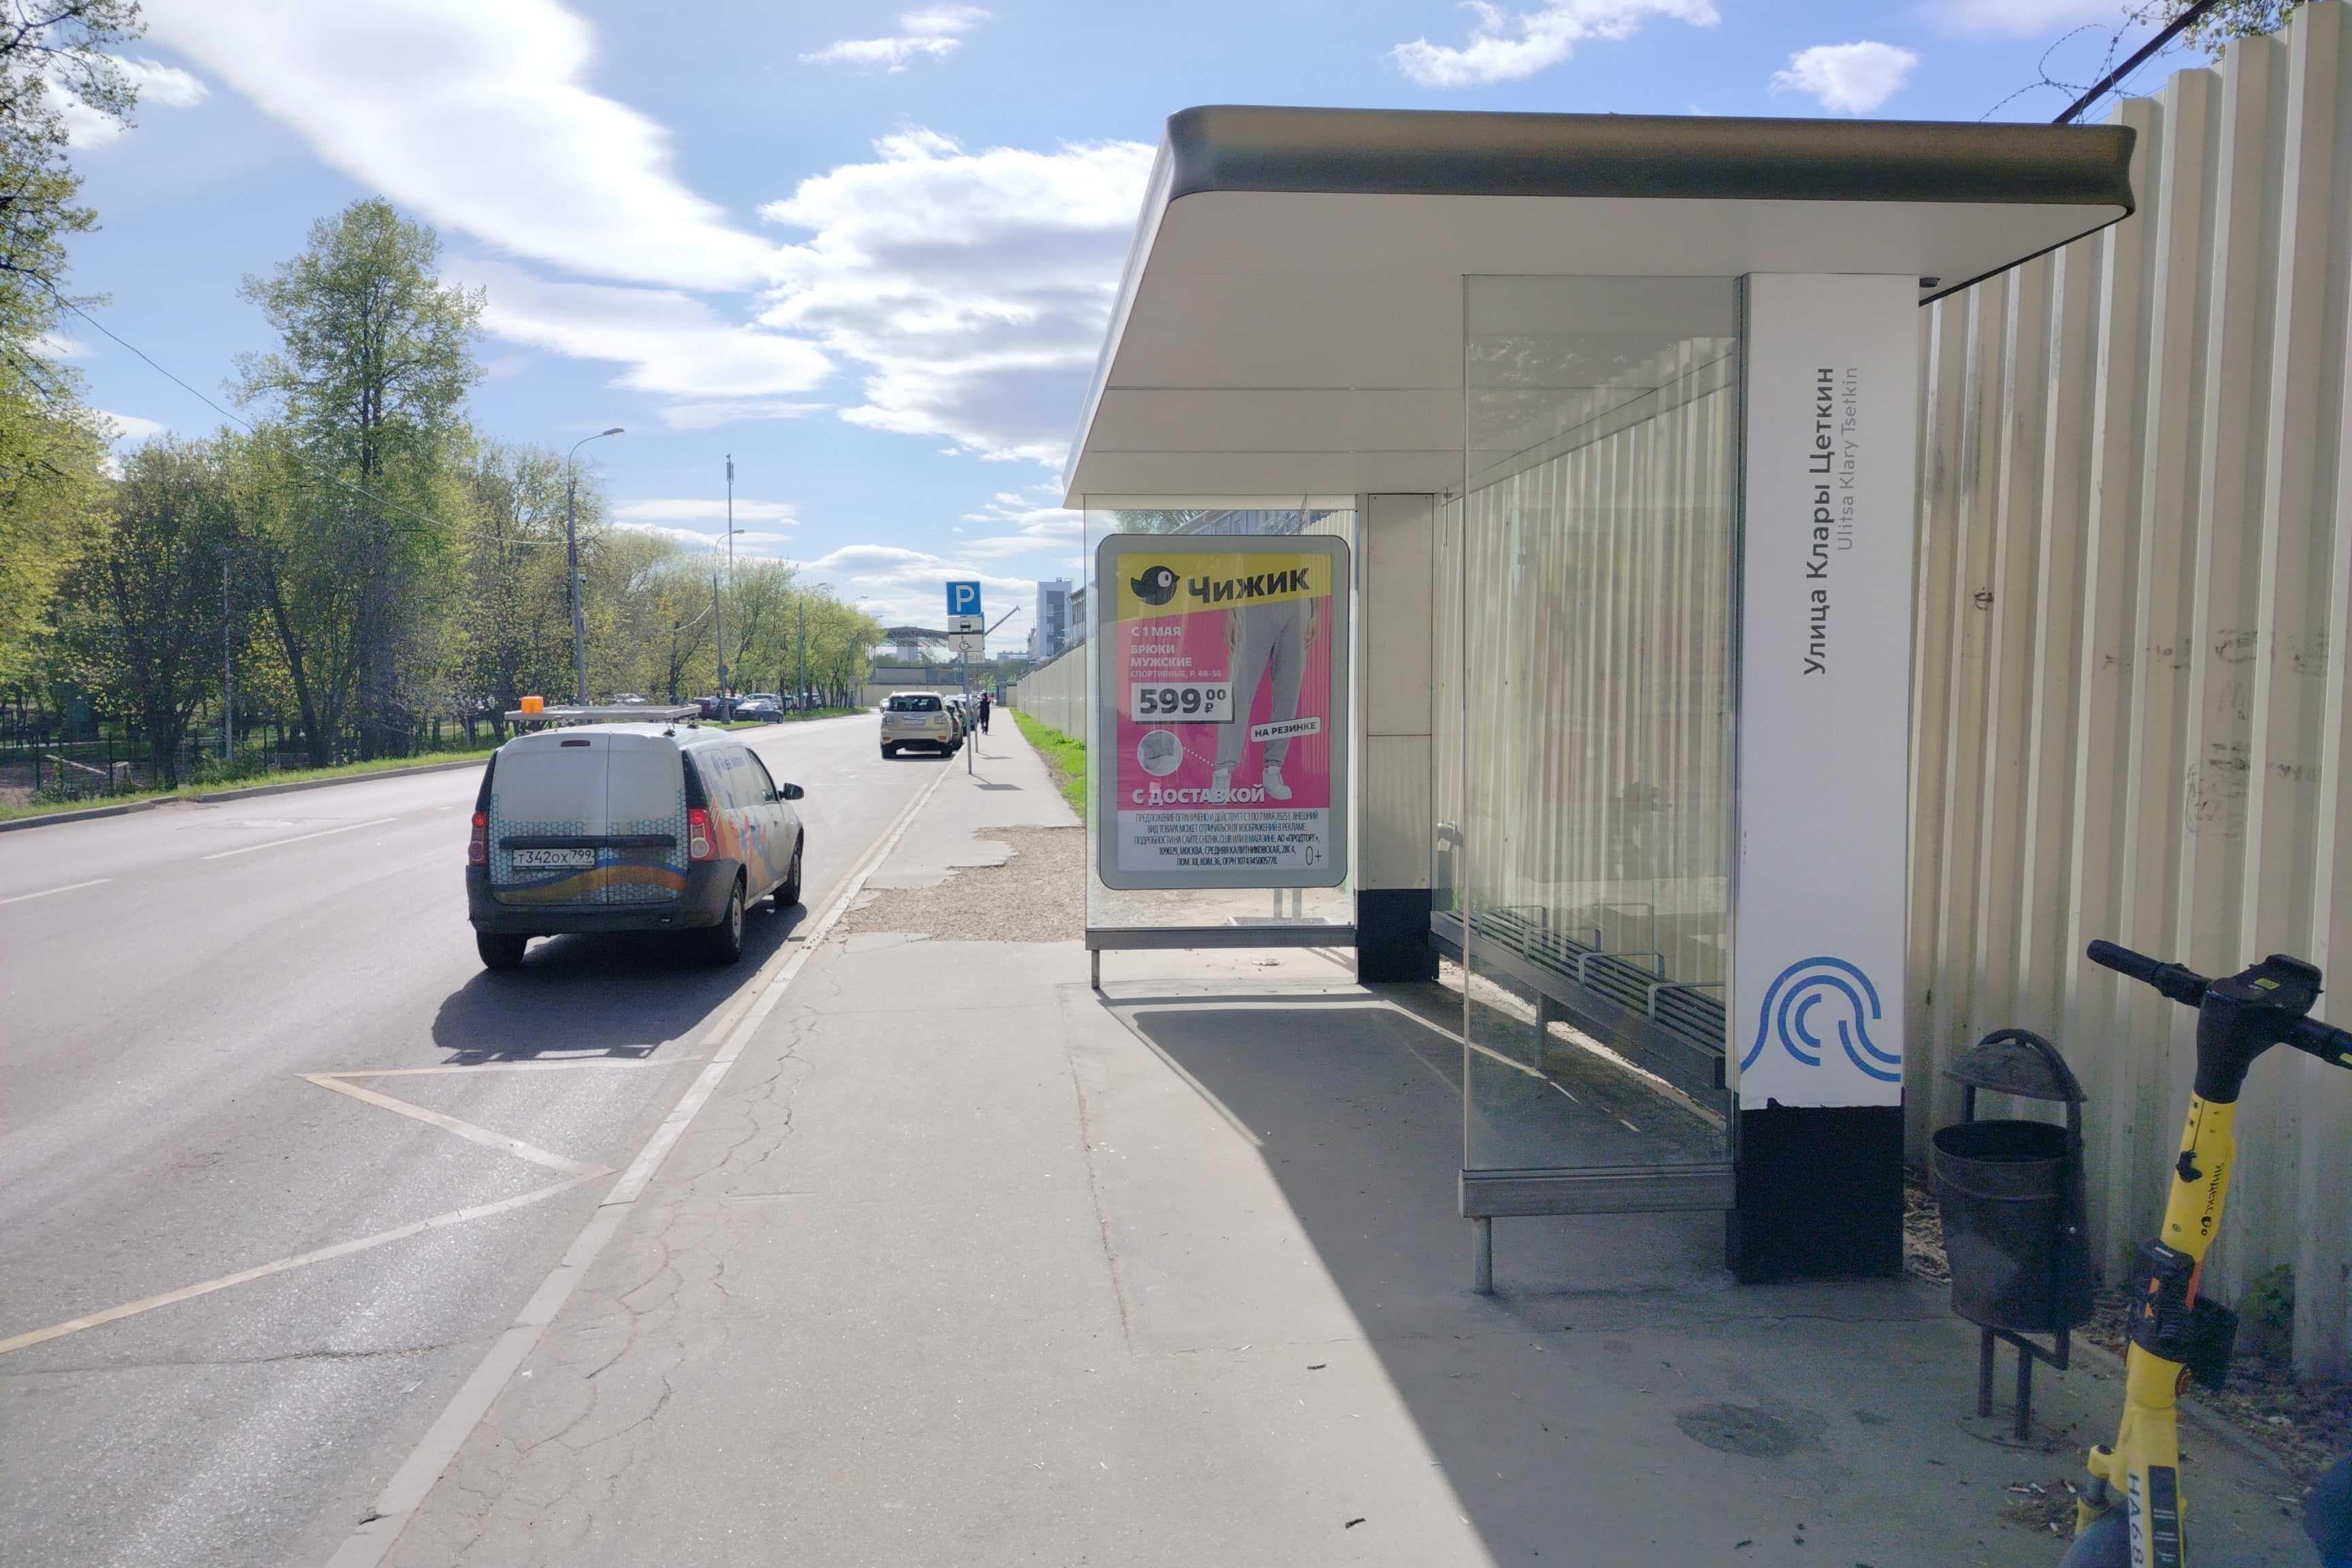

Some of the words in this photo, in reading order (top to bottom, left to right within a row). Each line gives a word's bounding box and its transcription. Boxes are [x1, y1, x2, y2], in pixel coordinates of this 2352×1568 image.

[1841, 367, 1858, 436] Tsetkin
[1809, 368, 1835, 474] Цеткин
[1839, 440, 1859, 489] Klary
[1806, 484, 1835, 579] Клары
[1838, 494, 1854, 551] Ulitsa
[1132, 627, 1139, 636] С
[1143, 627, 1149, 636] 1
[1152, 626, 1181, 636] МАЯ
[1803, 589, 1830, 676] Улица
[1130, 644, 1175, 654] БРЮКИ
[1130, 657, 1192, 668] МУЖСКИЕ
[1130, 670, 1188, 679] СПОРТИВНЫЕ,
[1139, 687, 1201, 714] 599
[1205, 689, 1227, 700] 00
[1255, 728, 1269, 738] НА
[1271, 721, 1318, 736] РЕЗИНКЕ
[1132, 789, 1144, 804] С
[1148, 783, 1265, 806] ДОСТАВКОЙ
[572, 849, 591, 860] 799
[1305, 846, 1322, 865] 0+
